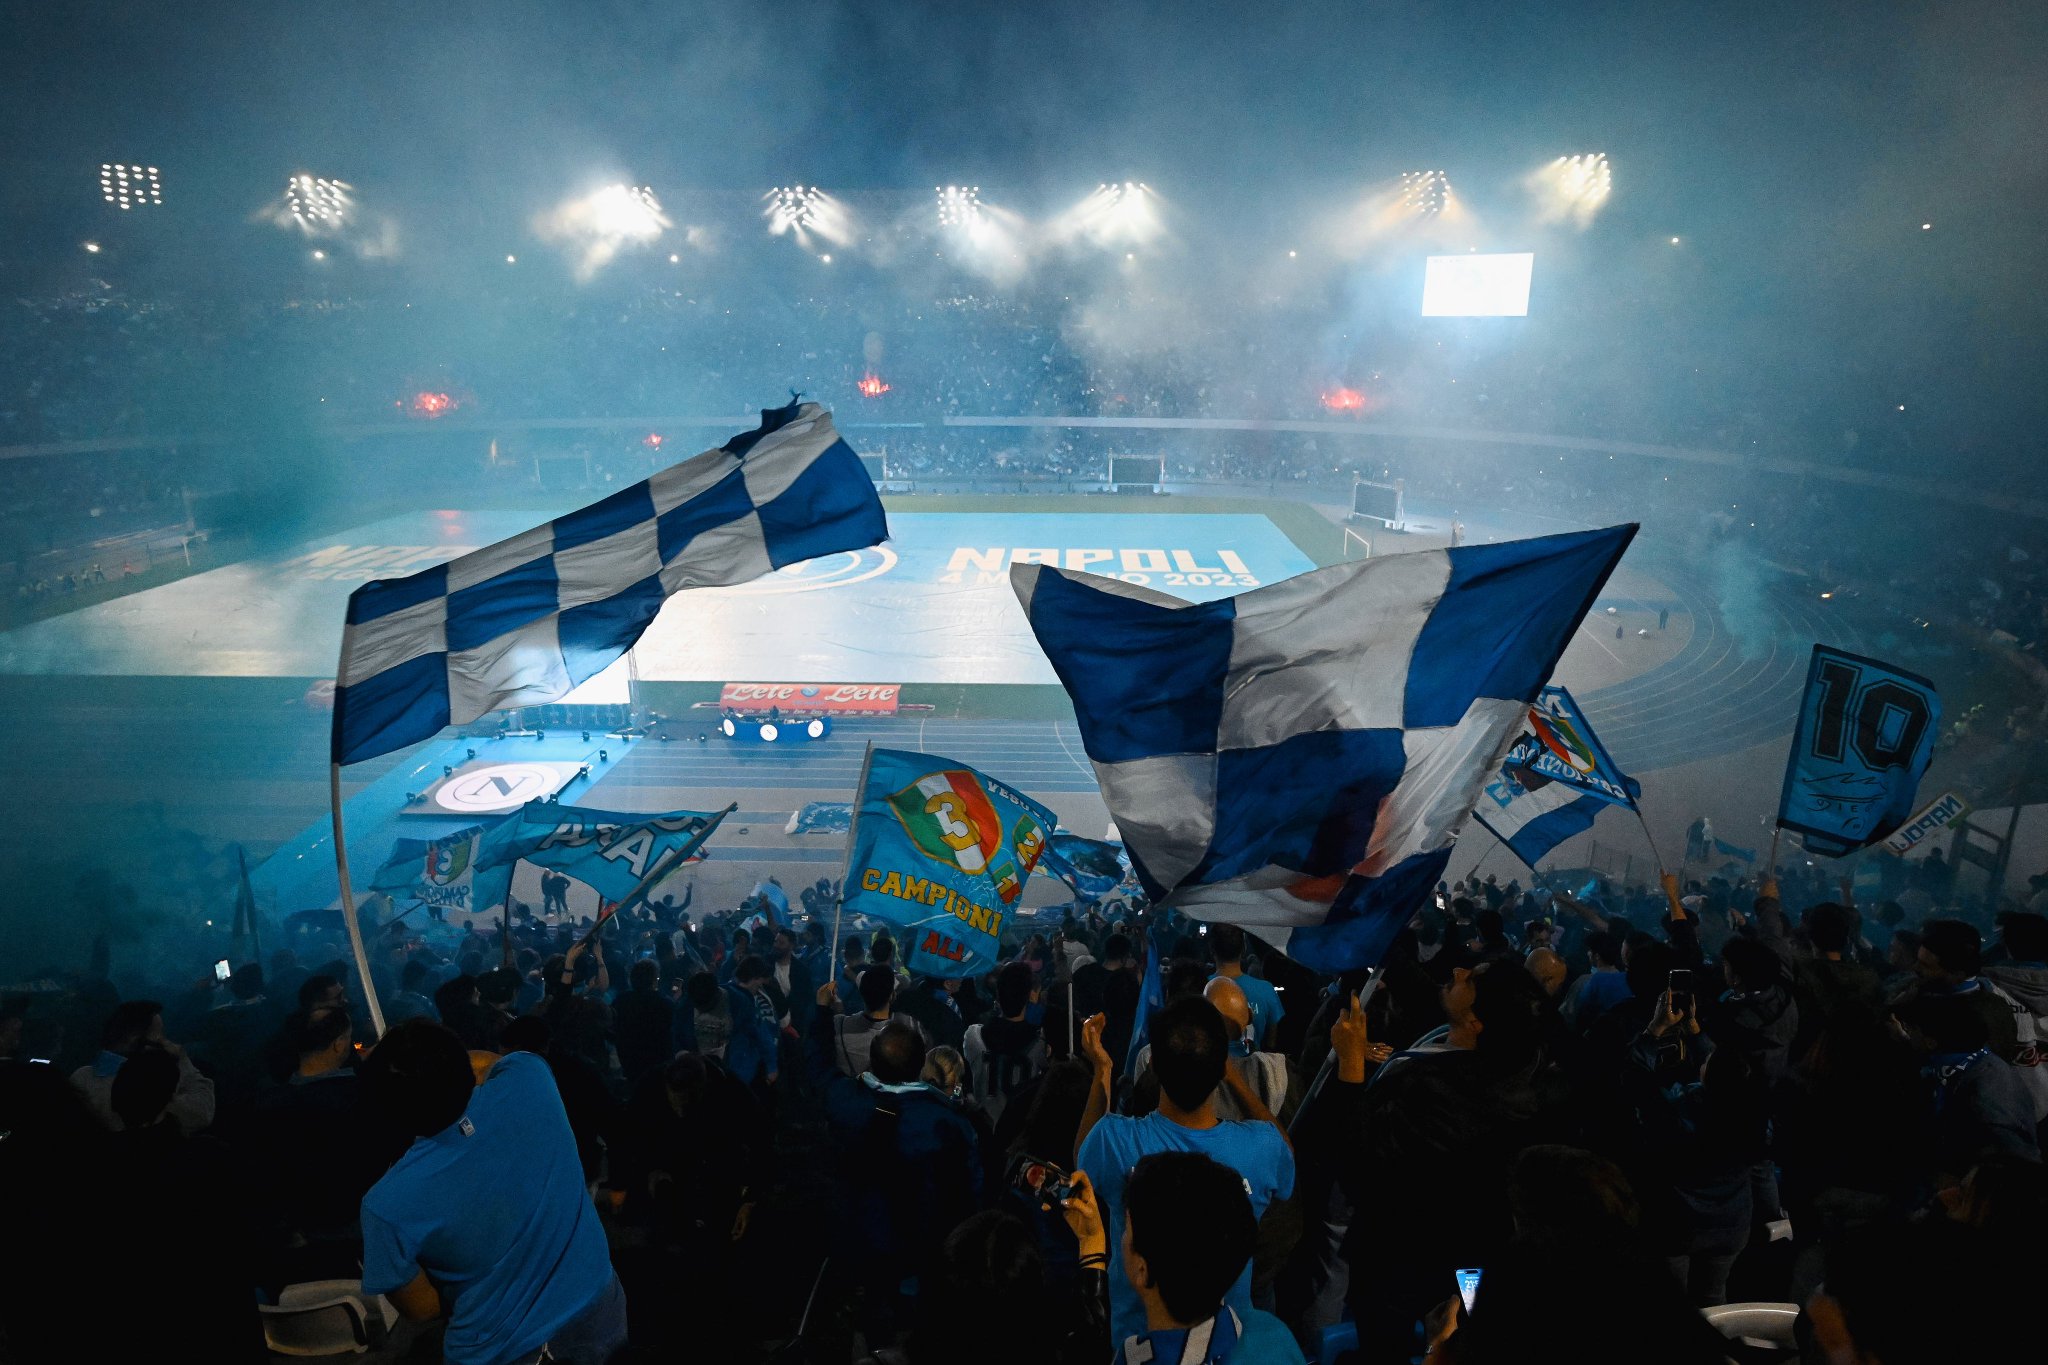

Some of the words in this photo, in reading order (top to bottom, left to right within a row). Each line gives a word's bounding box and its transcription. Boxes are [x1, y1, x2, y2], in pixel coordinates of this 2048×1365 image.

[946, 547, 1251, 574] NAPOLI
[1163, 573, 1261, 587] 2023
[724, 685, 794, 701] Lete
[824, 685, 895, 702] Lete
[1812, 657, 1932, 773] 10
[924, 792, 981, 850] 3
[861, 868, 1004, 937] CAMPIONI
